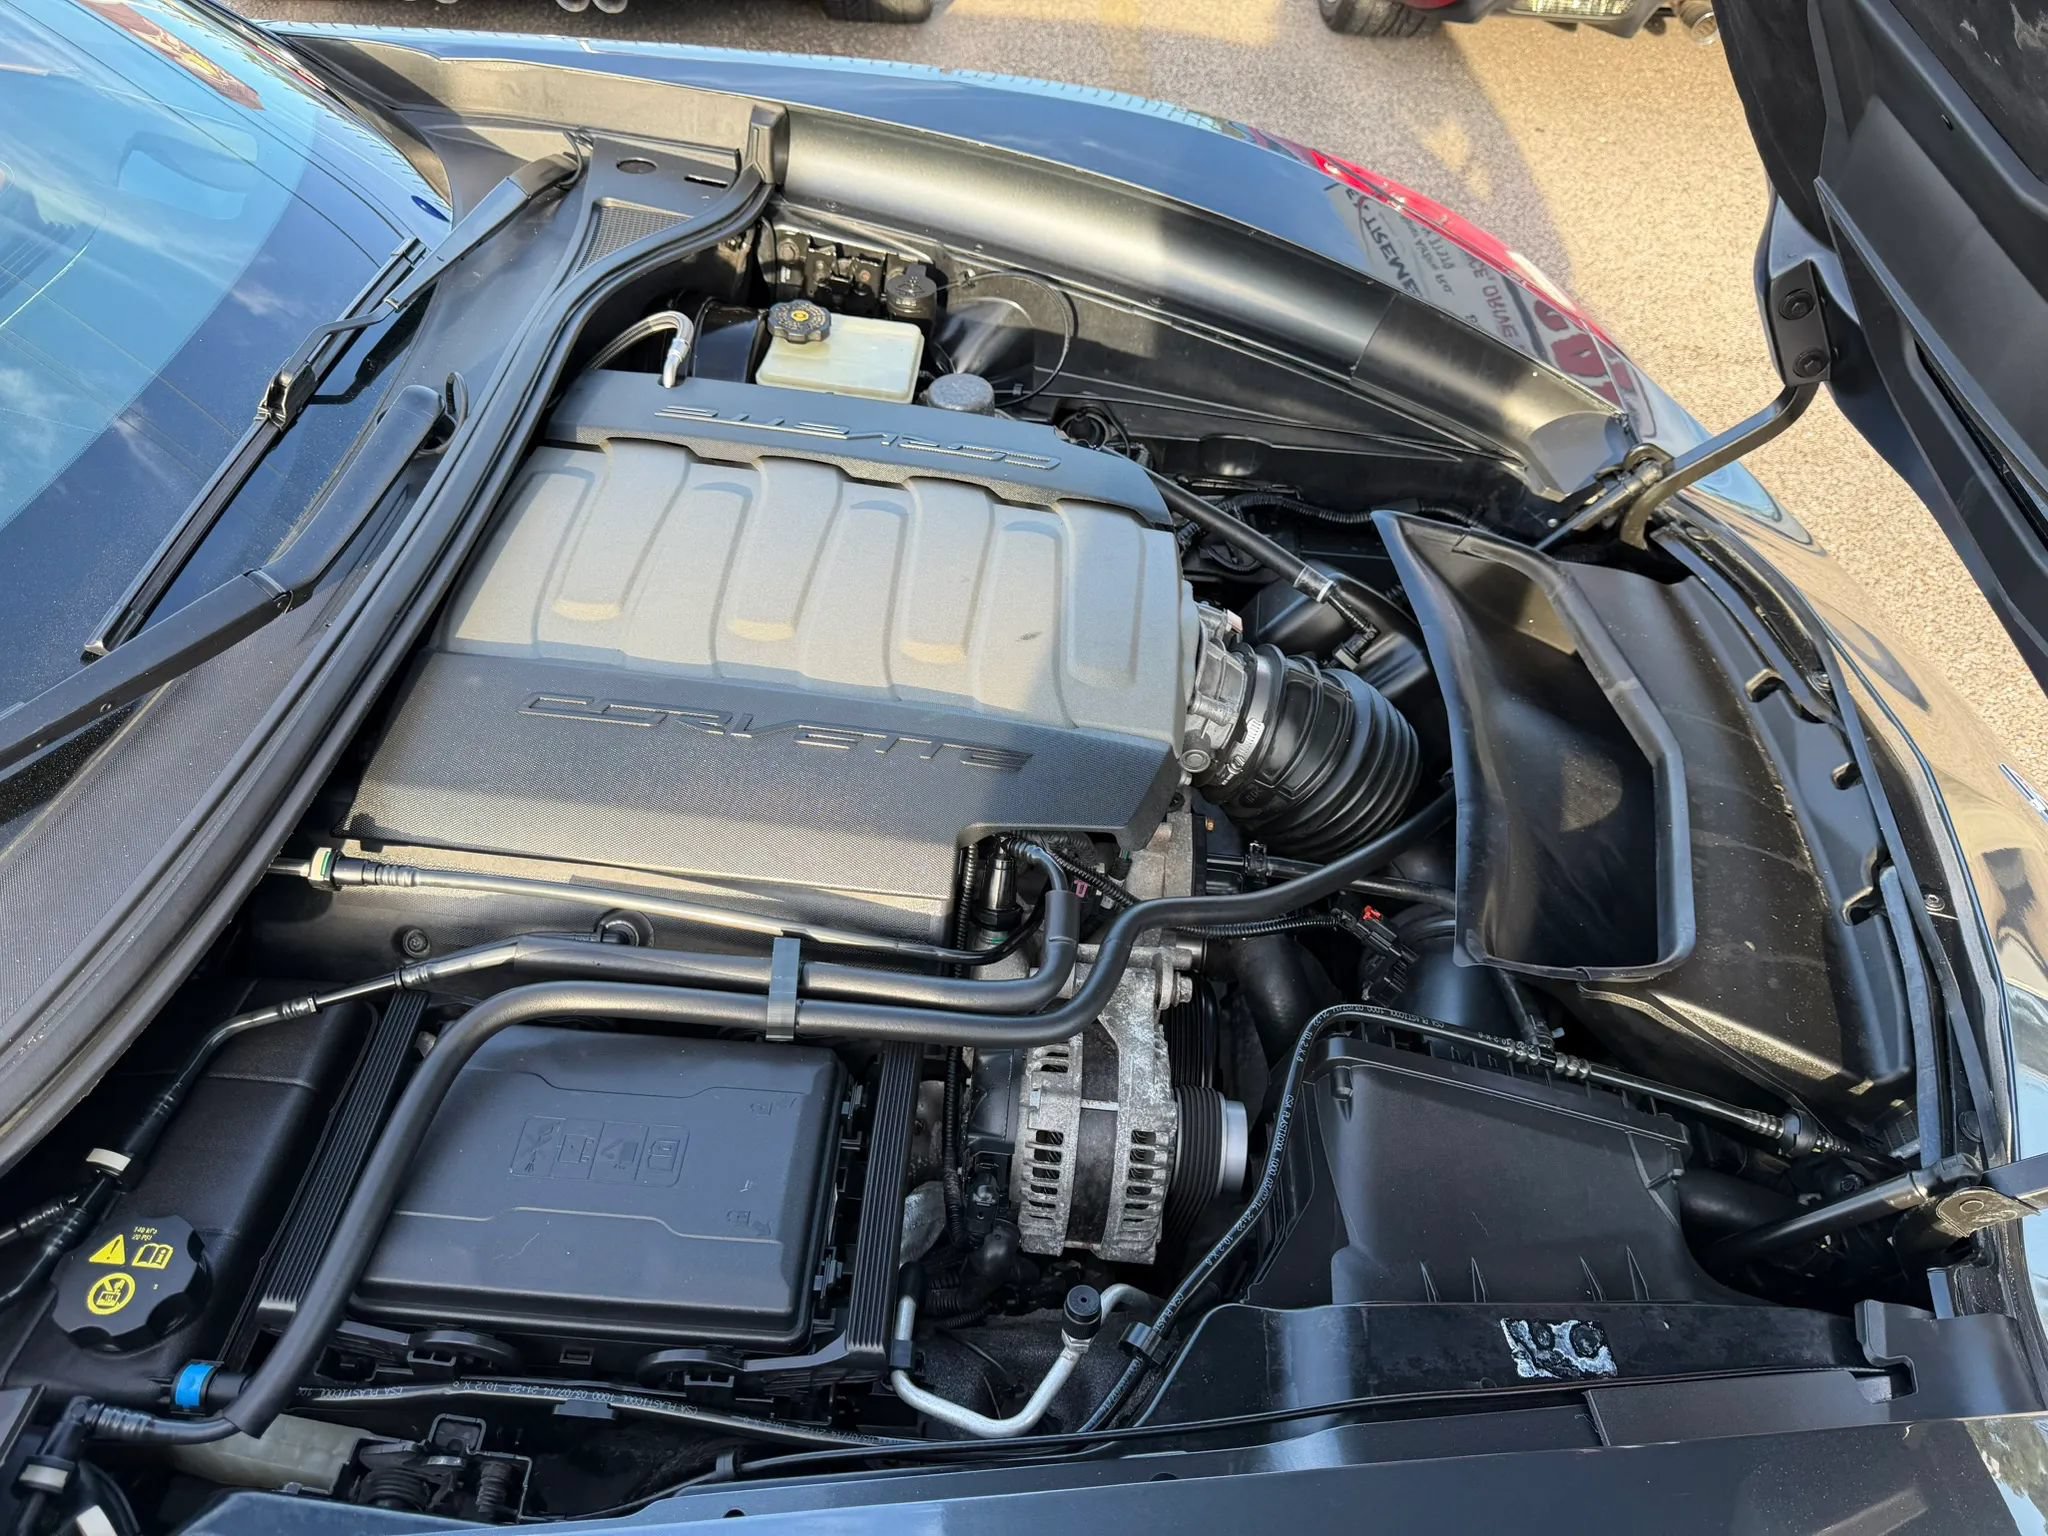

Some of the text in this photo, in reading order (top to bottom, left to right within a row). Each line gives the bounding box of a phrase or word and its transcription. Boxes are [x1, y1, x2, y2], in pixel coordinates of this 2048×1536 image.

[654, 404, 1062, 471] CORVETTE
[516, 691, 1035, 772] CORVETTE
[1299, 1031, 1313, 1048] 10.2
[1284, 1094, 1295, 1108] CSA
[1273, 1110, 1291, 1153] PLASTICOOL
[1267, 1159, 1281, 1176] 1000
[1251, 1178, 1274, 1211] 03/07/14
[1218, 1235, 1234, 1252] 10.2
[475, 1381, 498, 1392] 10.2
[543, 1387, 588, 1400] 03/07/14
[592, 1391, 615, 1403] 1000
[622, 1395, 678, 1414] PLASTICOOL
[680, 1404, 698, 1416] CSA
